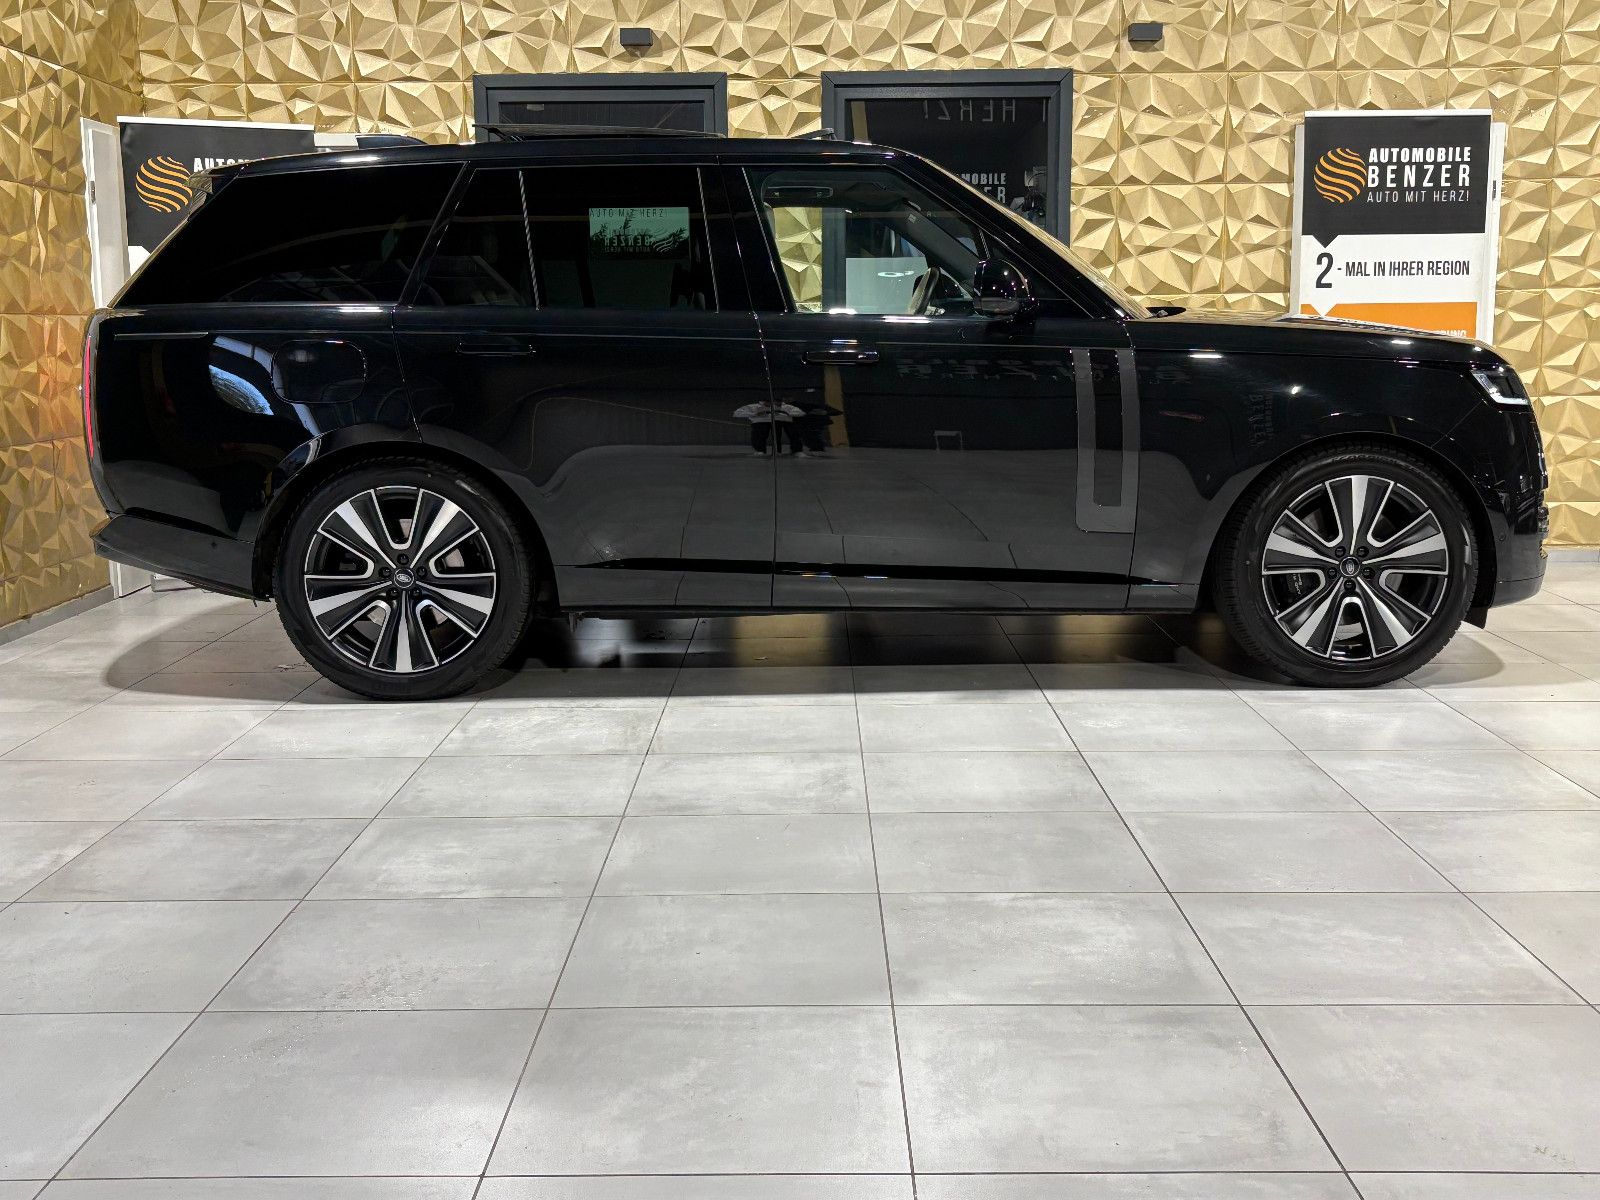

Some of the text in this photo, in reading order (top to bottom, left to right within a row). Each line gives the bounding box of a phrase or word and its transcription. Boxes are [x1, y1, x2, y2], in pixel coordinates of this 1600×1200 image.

[1368, 146, 1472, 163] AUTOMOBILE
[956, 172, 1007, 185] MOBILE
[1367, 164, 1471, 188] BENZER
[1366, 189, 1470, 203] AUTO MIT HERZ!
[1315, 252, 1334, 289] 2
[1345, 261, 1370, 277] MAL
[1373, 261, 1386, 276] IN
[1389, 260, 1424, 276] IHRER
[1427, 260, 1470, 276] REGION
